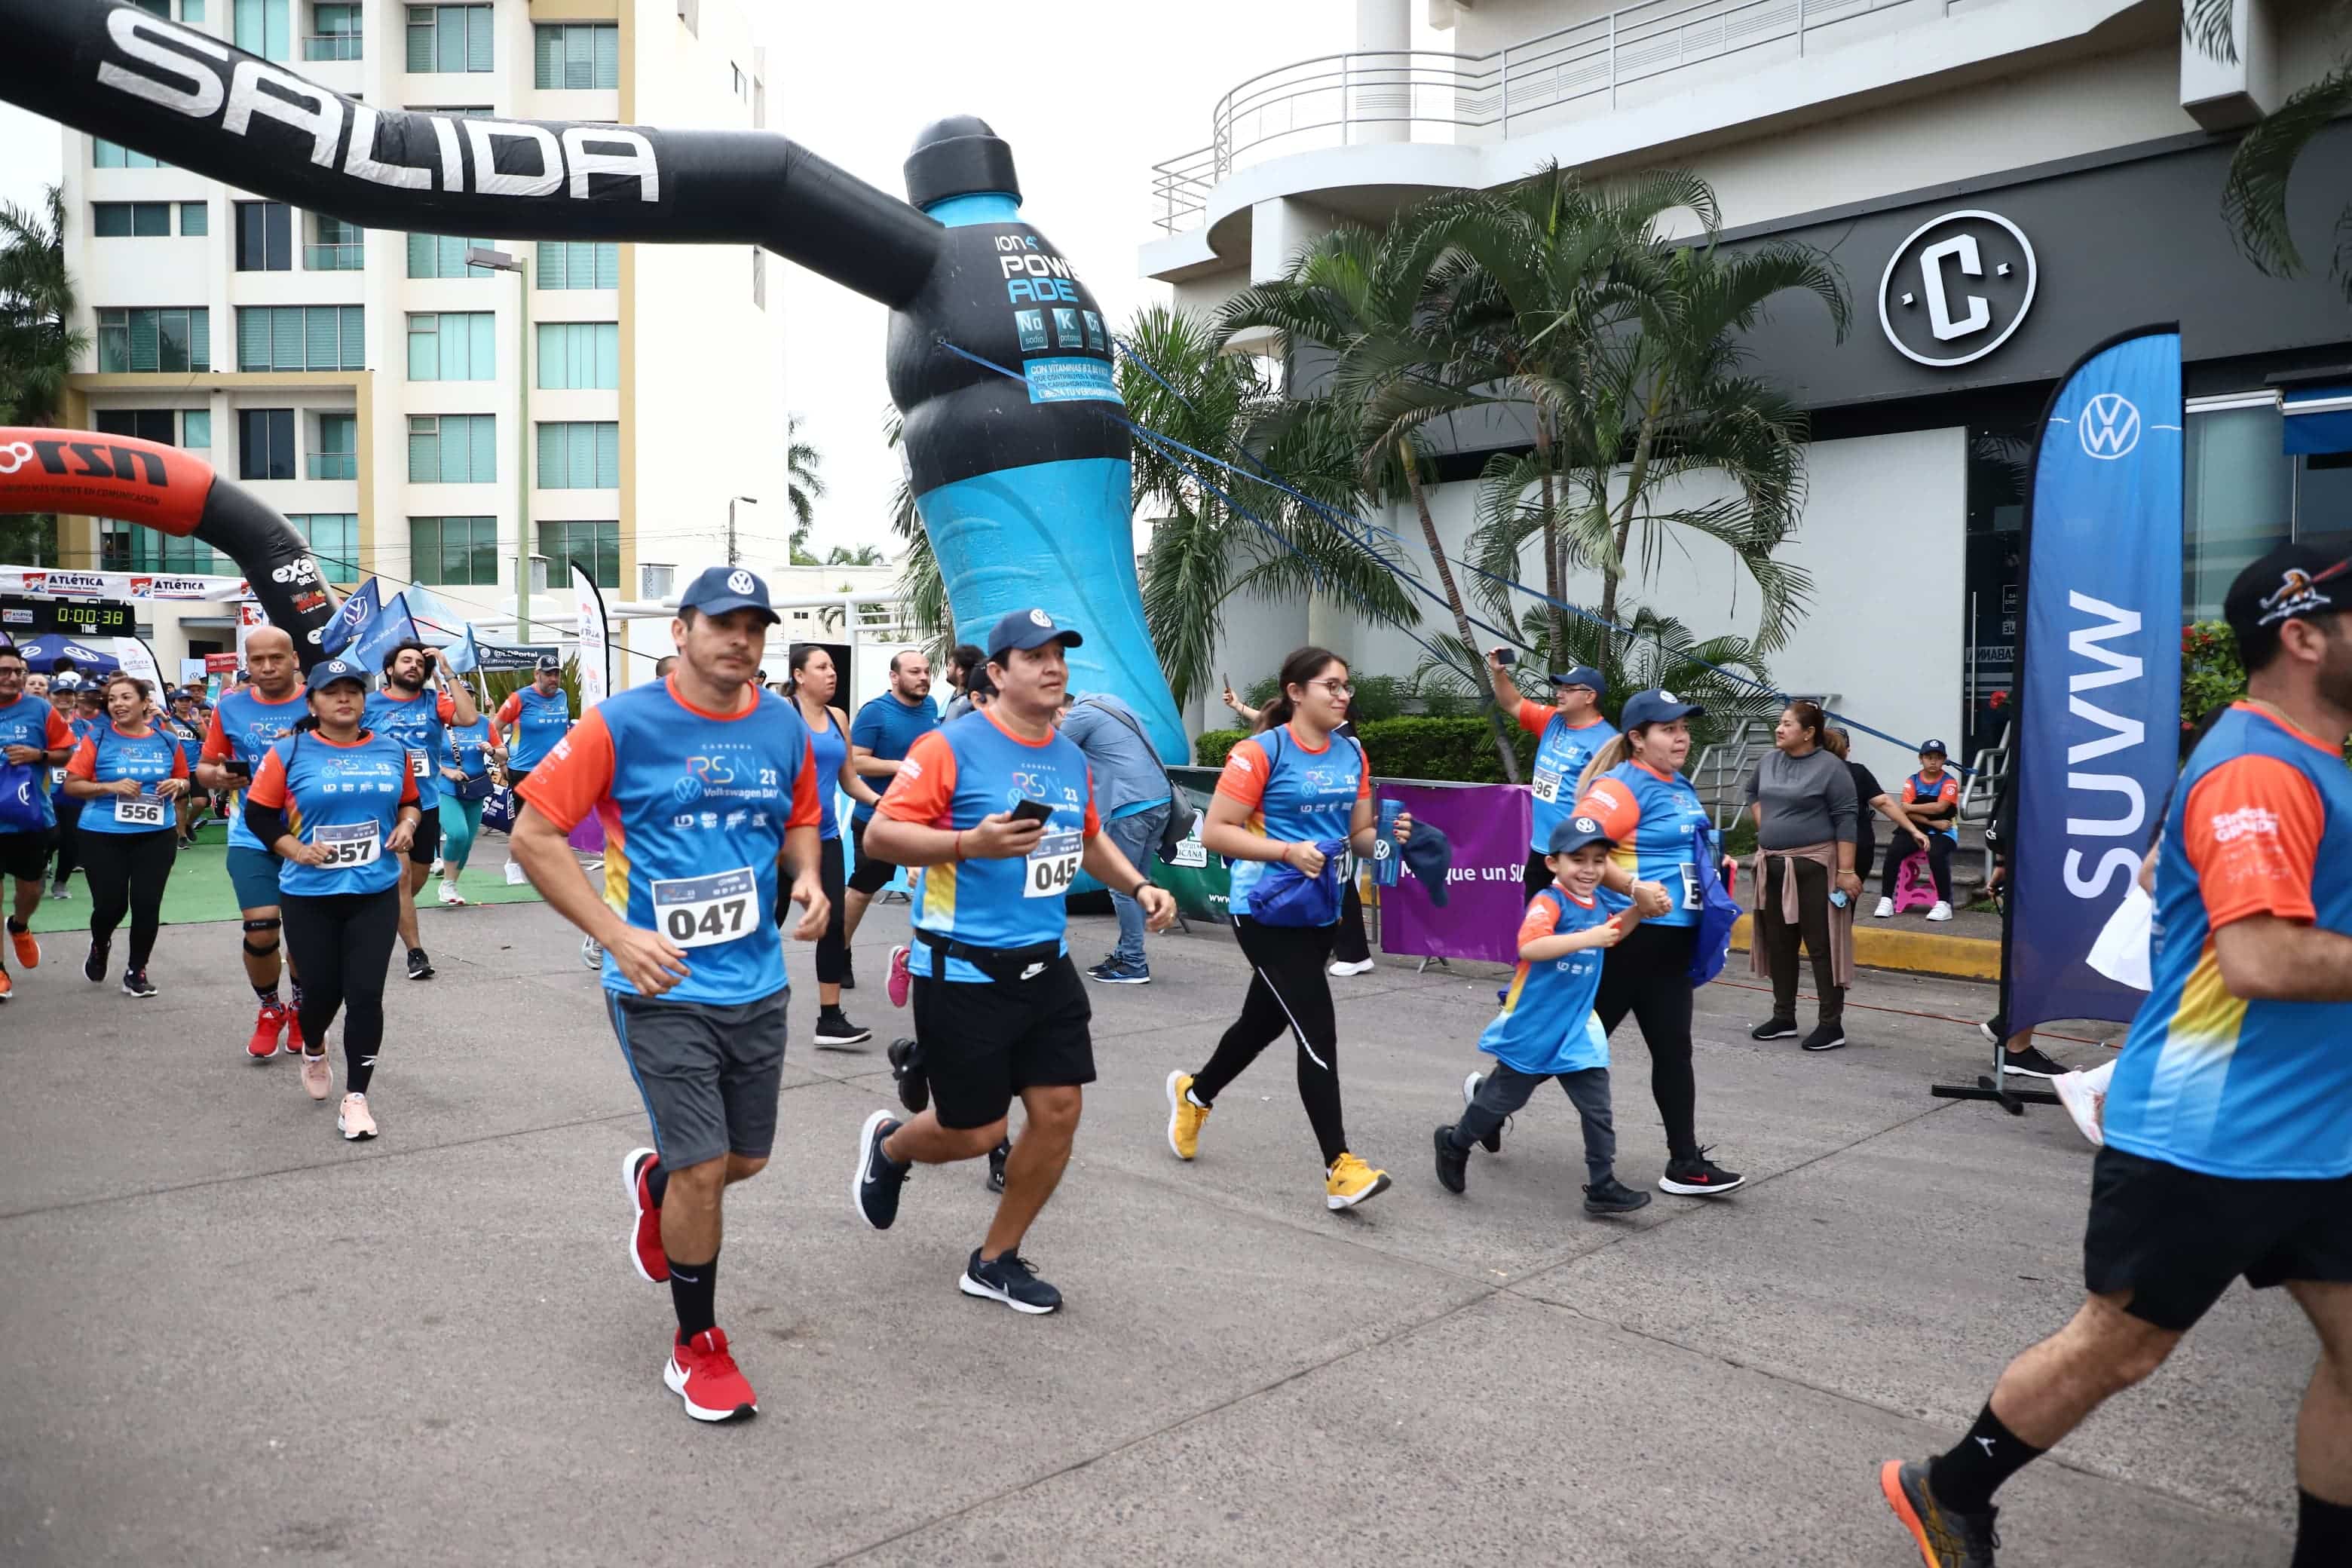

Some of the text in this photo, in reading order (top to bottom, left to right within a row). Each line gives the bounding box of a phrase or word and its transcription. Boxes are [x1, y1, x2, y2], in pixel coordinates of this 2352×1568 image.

[97, 8, 660, 202] SALIDA
[1008, 277, 1079, 304] ADE
[1019, 317, 1043, 332] Na
[1060, 313, 1074, 329] K
[1025, 335, 1043, 345] sodio
[1031, 365, 1047, 375] CON
[1049, 363, 1082, 374] VITAMINAS
[298, 573, 317, 586] 98.1
[58, 608, 124, 625] 0:00:38
[81, 623, 98, 633] TIME
[703, 788, 761, 800] Volkswagen
[121, 804, 158, 820] 556
[1036, 858, 1077, 890] 045
[1482, 867, 1506, 881] un
[668, 899, 746, 940] 047
